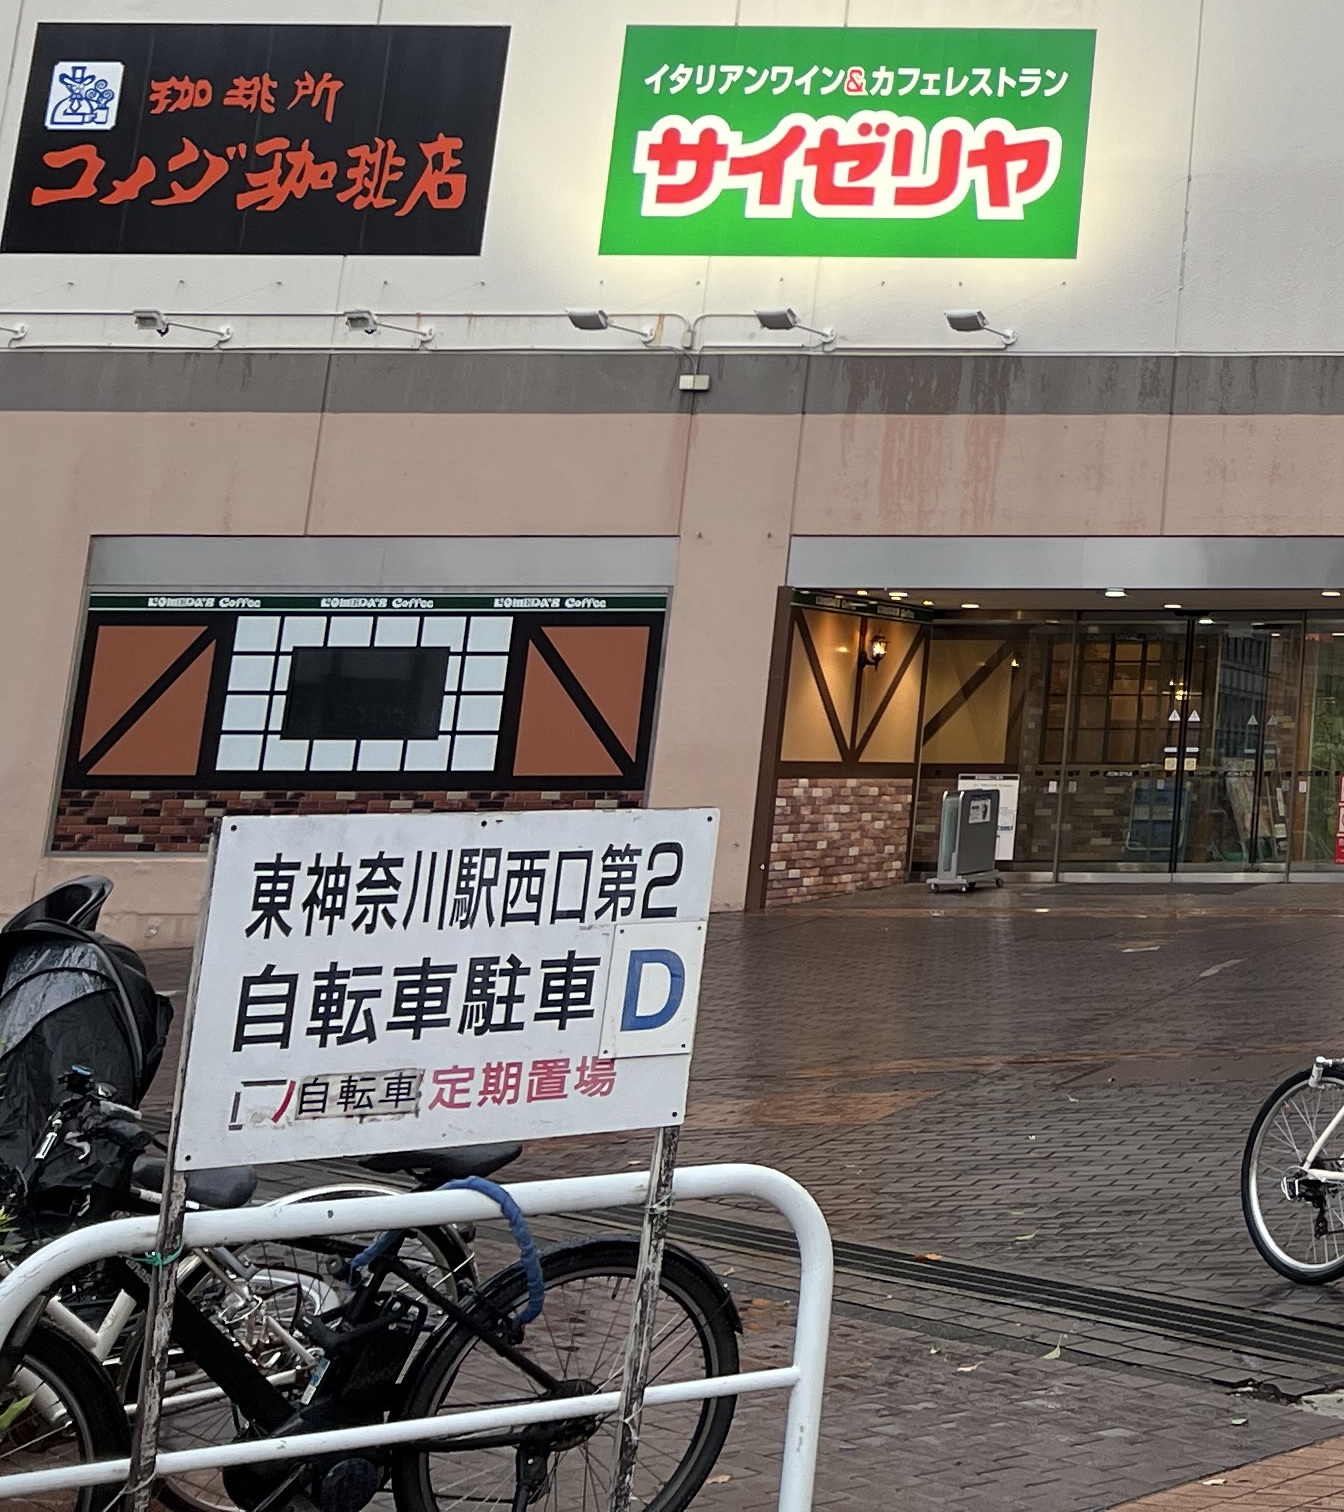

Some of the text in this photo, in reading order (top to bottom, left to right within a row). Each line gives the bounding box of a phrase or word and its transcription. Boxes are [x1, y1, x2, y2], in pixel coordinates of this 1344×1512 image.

[147, 70, 345, 124] 珈琲所
[643, 63, 1069, 97] イタリアンワイン&カフェレストラン
[30, 132, 469, 217] コメダ珈琲店
[642, 116, 1054, 214] サイゼリヤ
[218, 597, 262, 608] Coffee
[391, 597, 434, 608] Coffee
[564, 597, 607, 608] Coffee
[243, 841, 684, 941] 東神奈川駅西口第2
[232, 949, 687, 1053] 自転車駐車 D
[297, 1056, 618, 1116] 自転車 定期置場
